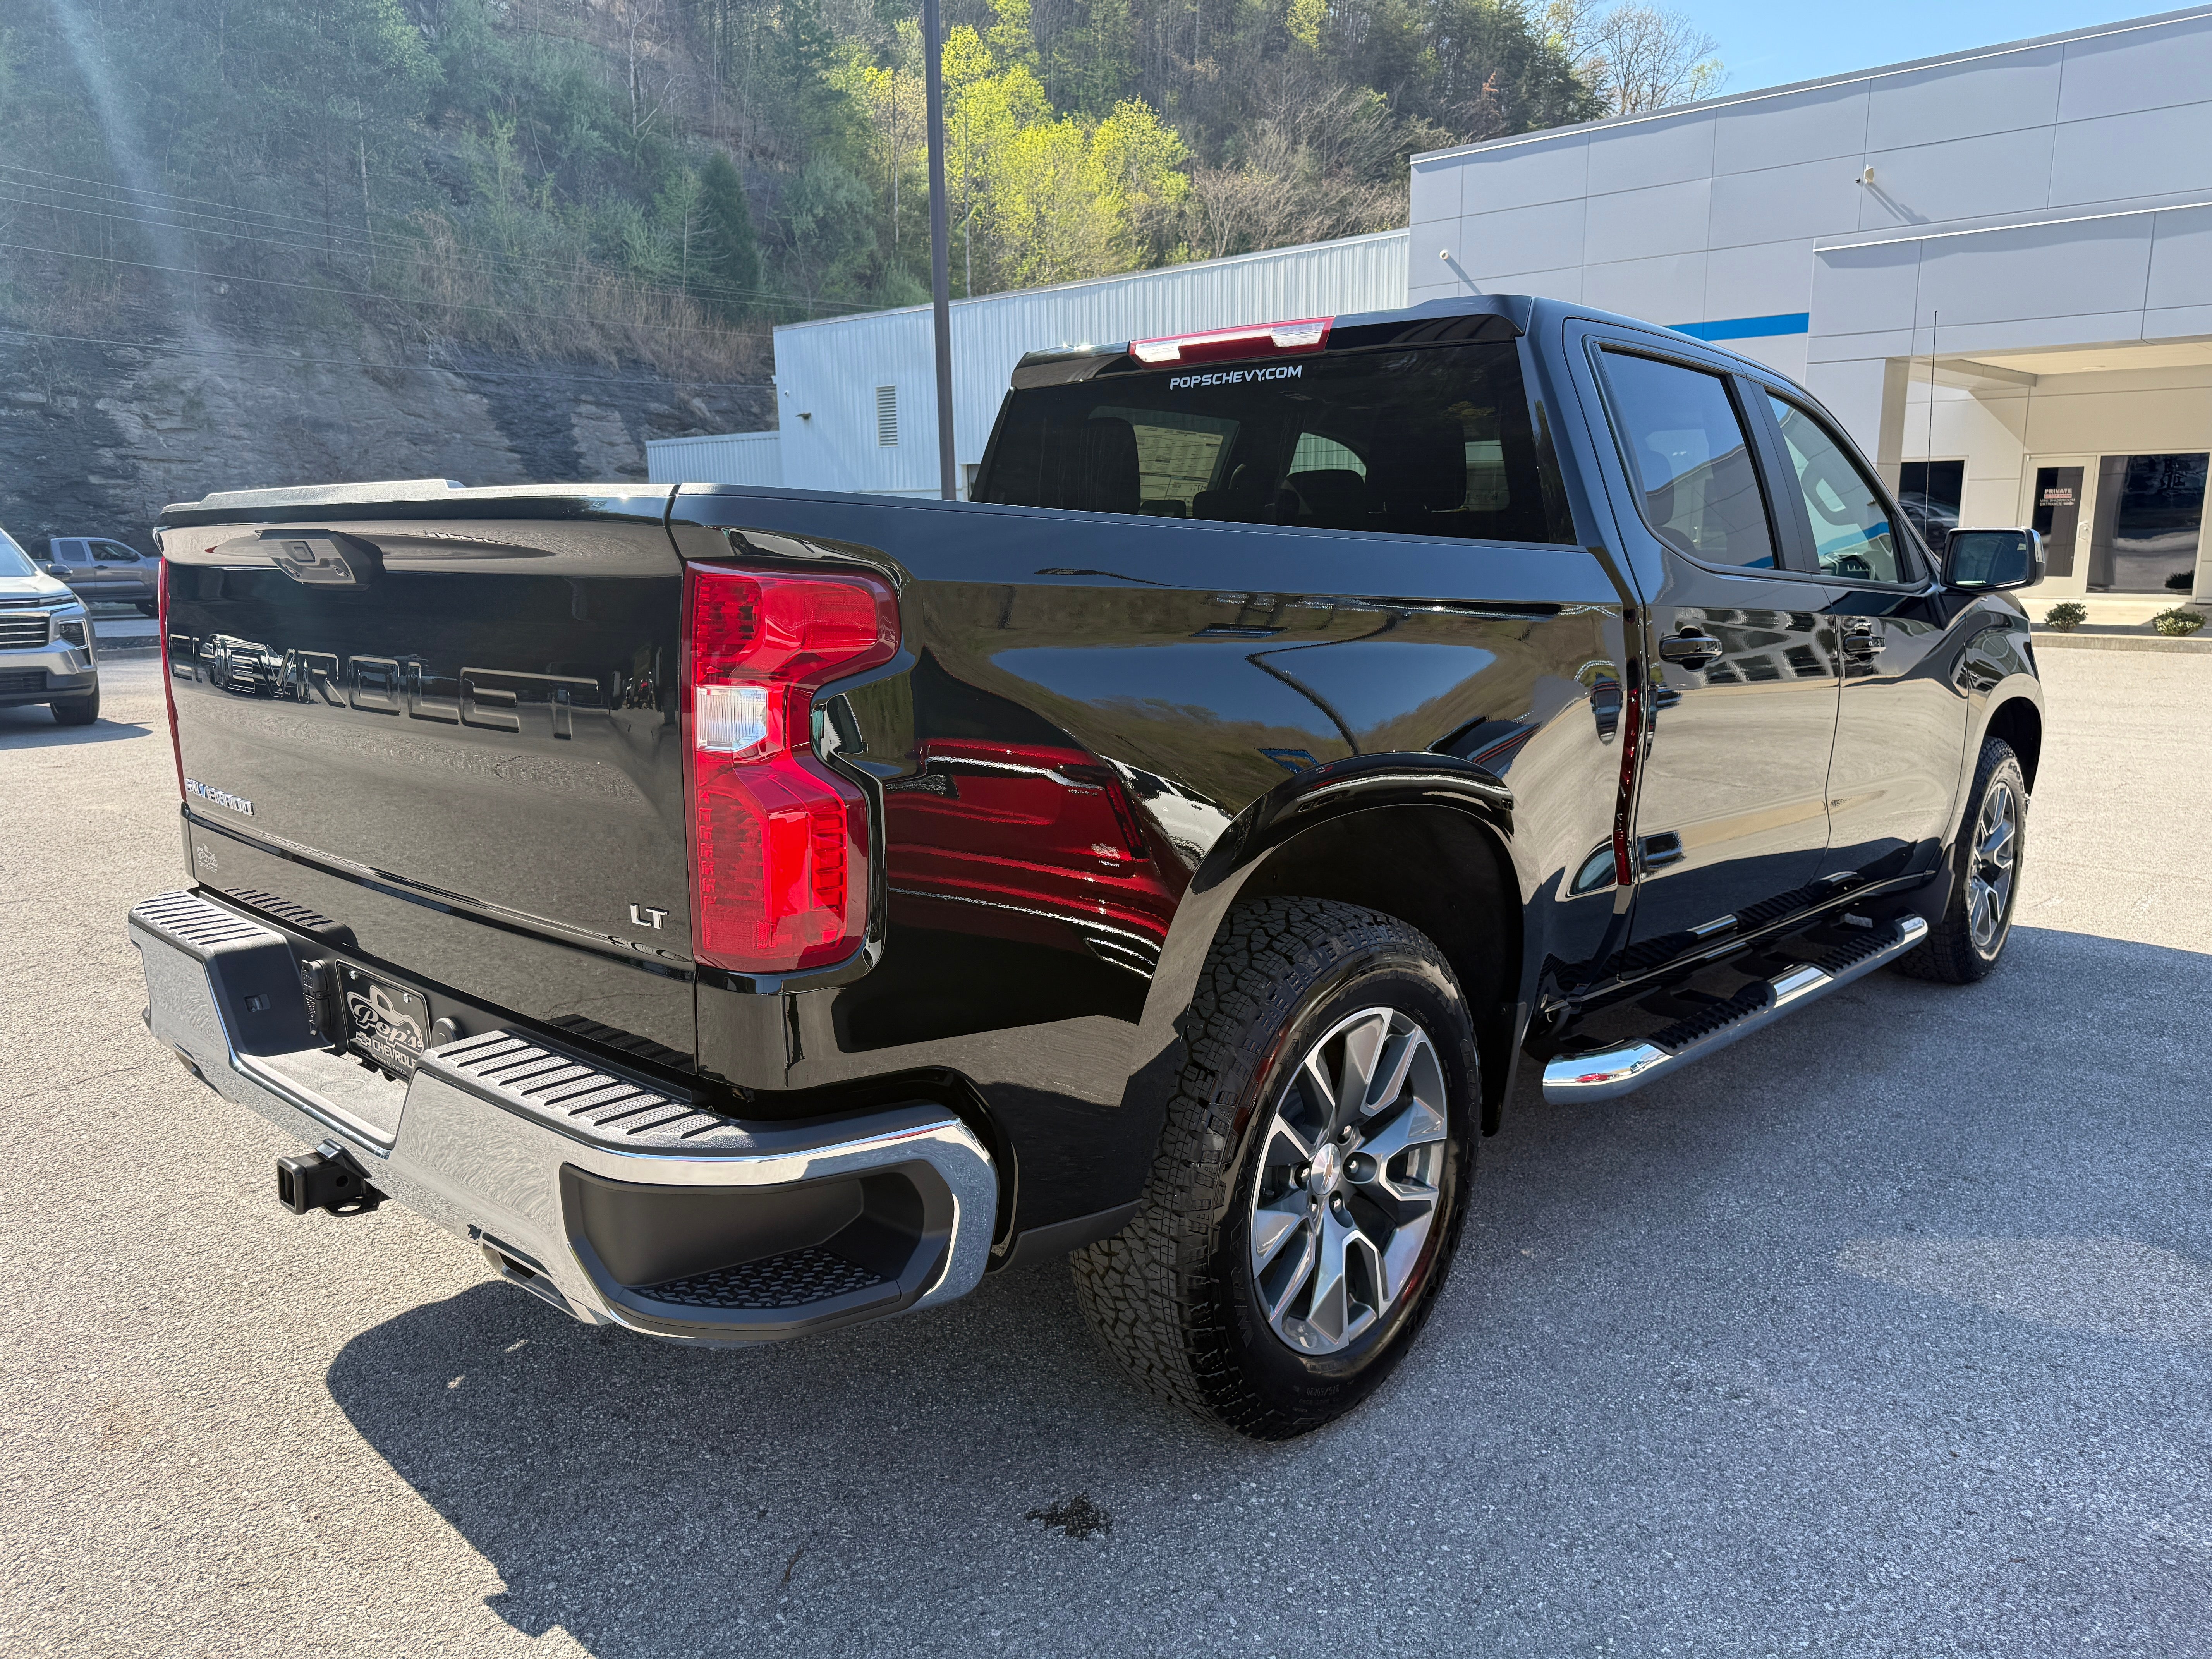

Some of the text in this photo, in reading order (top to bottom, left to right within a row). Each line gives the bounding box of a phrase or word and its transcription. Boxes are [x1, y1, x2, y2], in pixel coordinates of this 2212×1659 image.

[1170, 366, 1302, 390] POPSCHEVY.COM
[169, 634, 599, 740] CHEVROLET
[185, 778, 254, 816] SILVERADO
[630, 903, 669, 929] LT
[354, 1004, 420, 1050] Pop's
[373, 1039, 417, 1068] CHEVROLE
